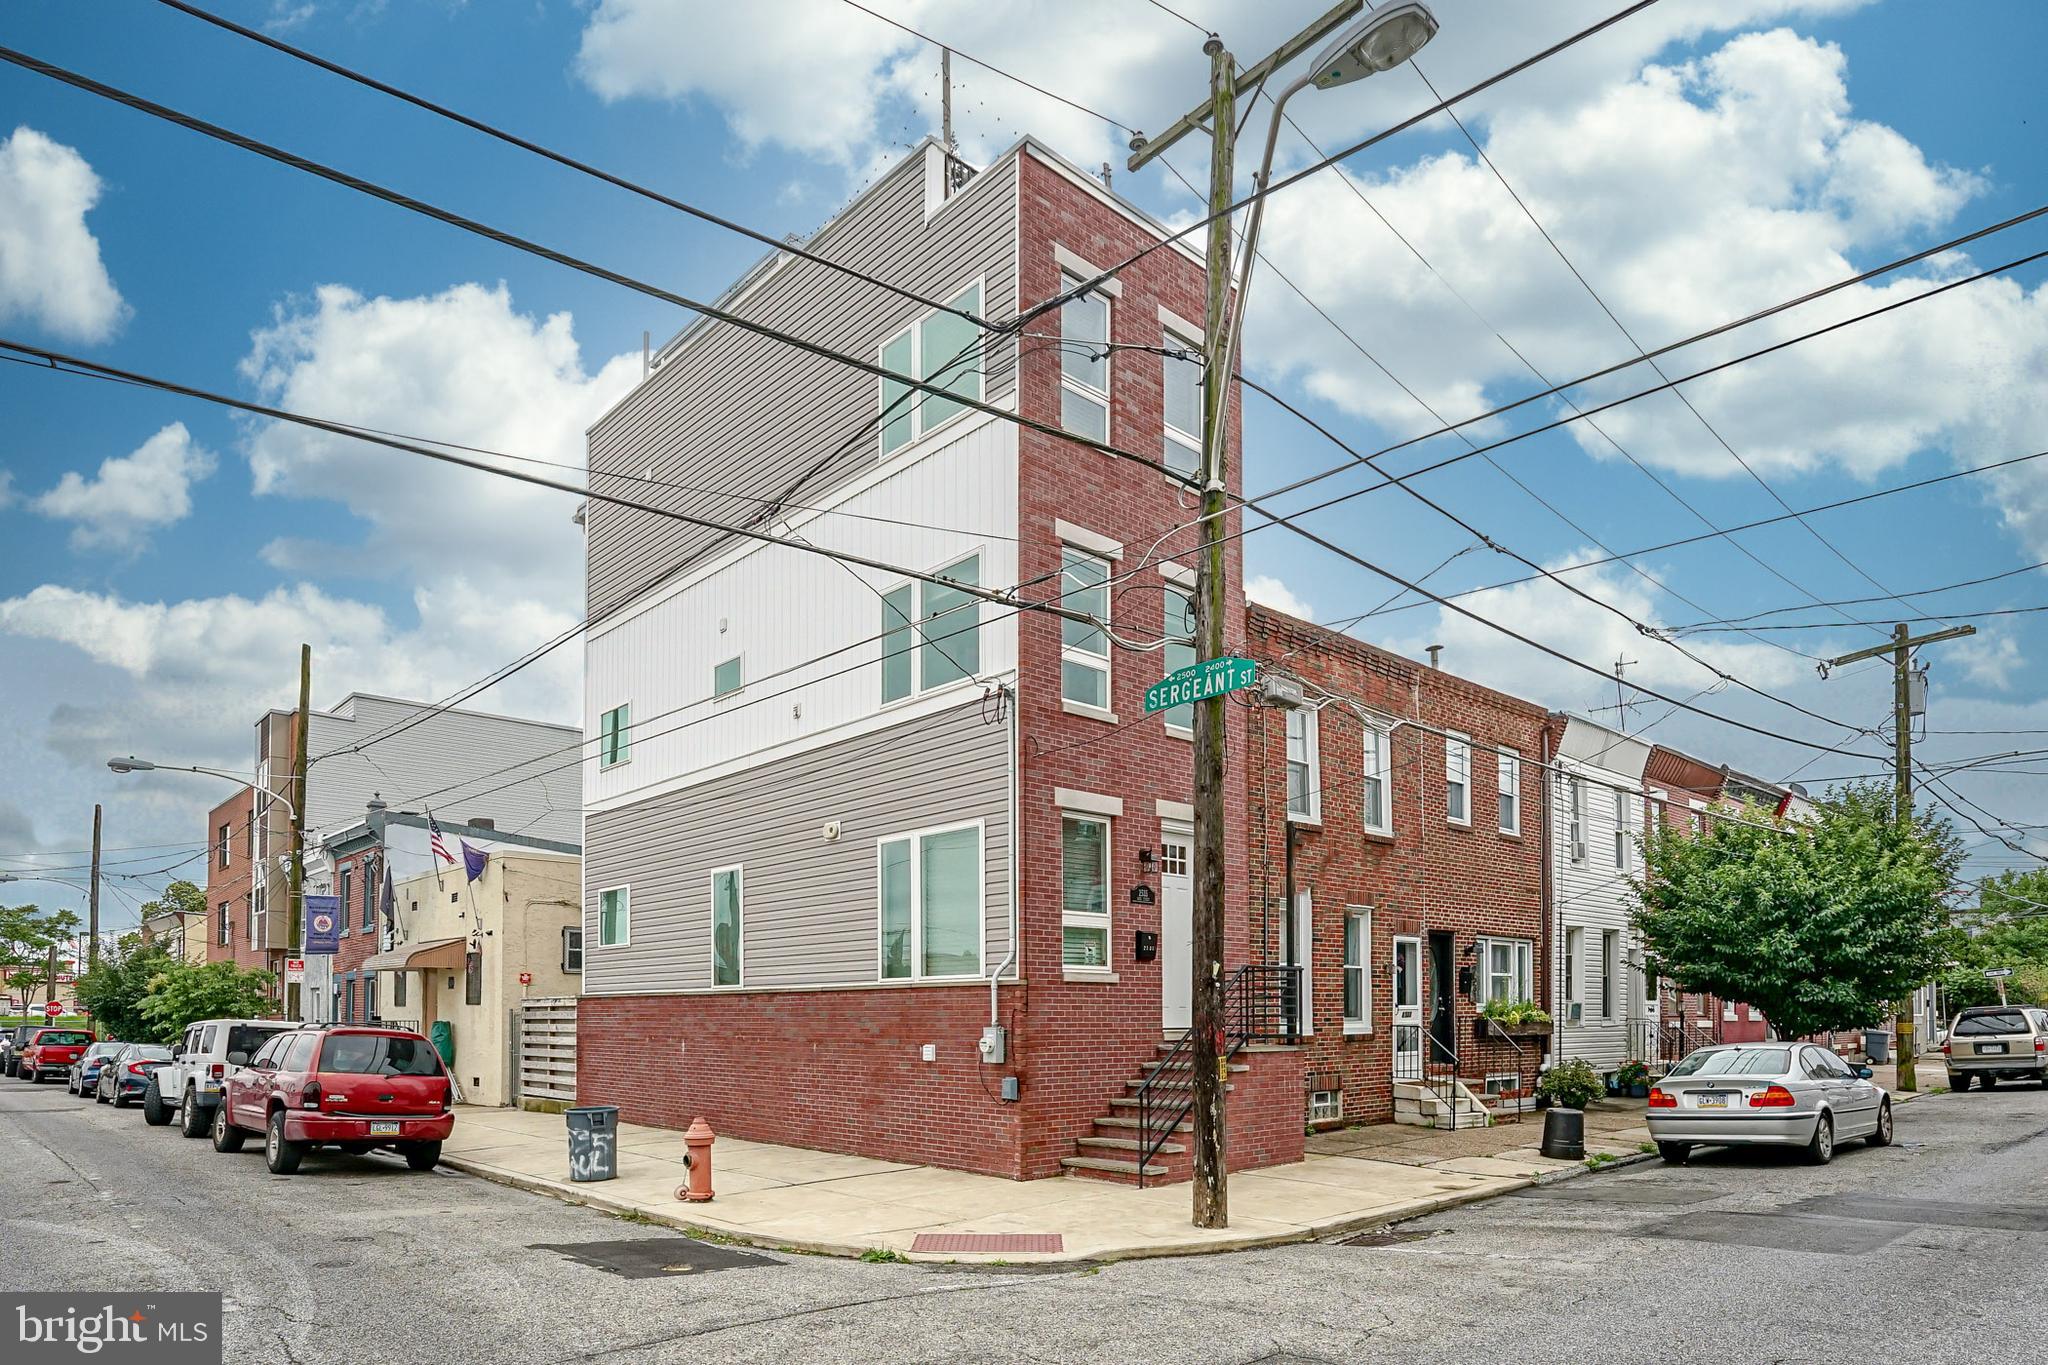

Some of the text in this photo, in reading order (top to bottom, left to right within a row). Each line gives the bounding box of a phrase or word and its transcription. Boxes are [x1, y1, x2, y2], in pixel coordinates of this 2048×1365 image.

[1176, 661, 1225, 680] 2500 2400
[1149, 668, 1252, 708] SERGEANT ST
